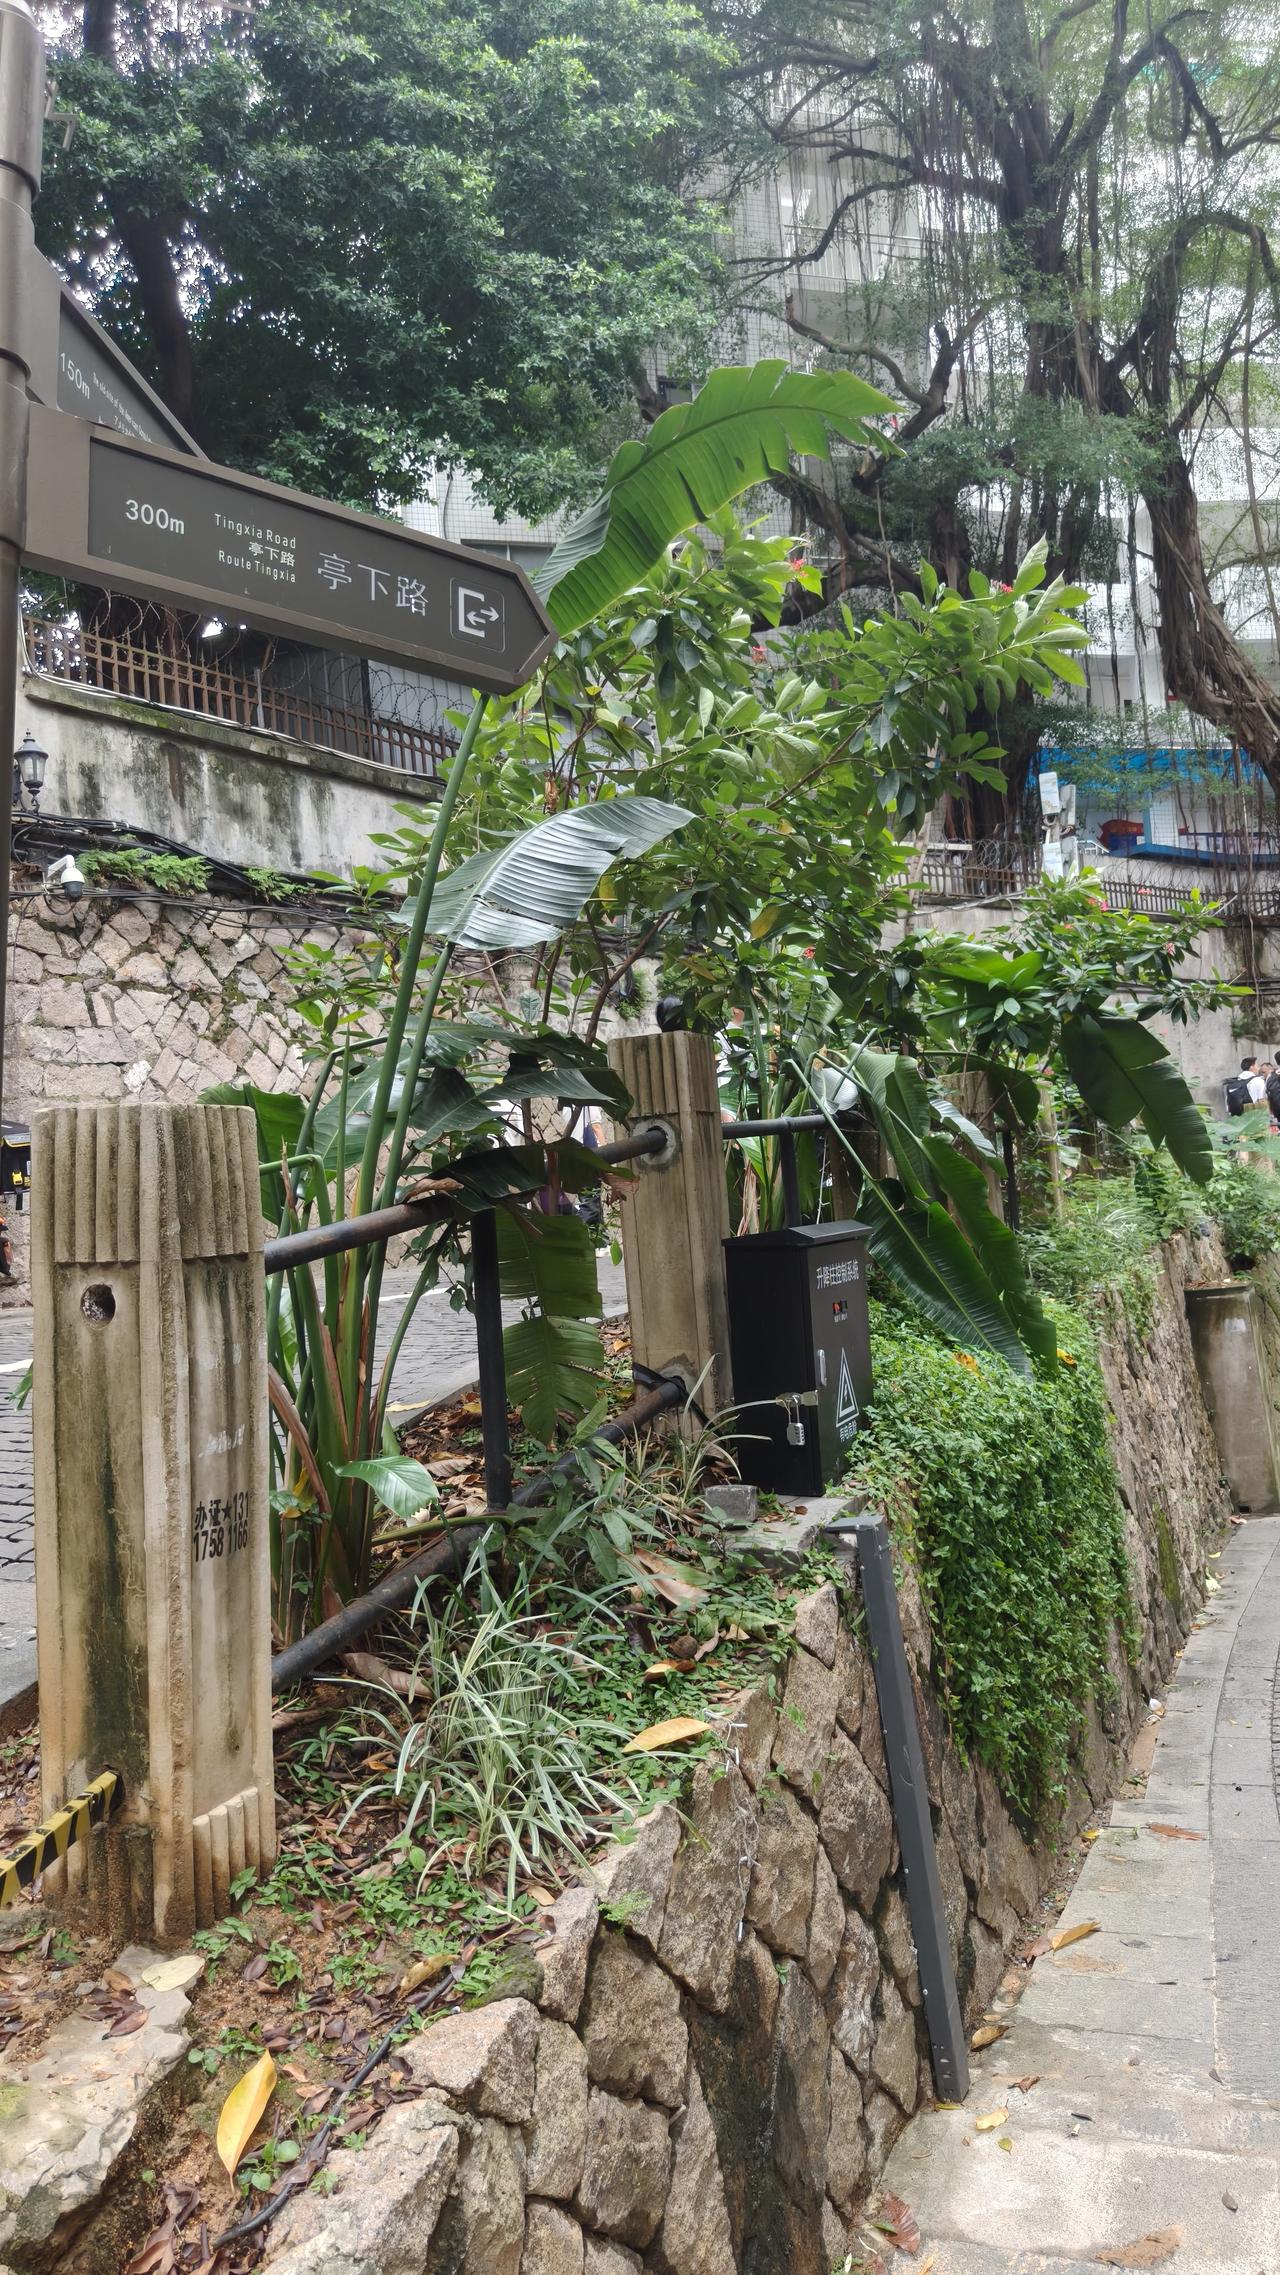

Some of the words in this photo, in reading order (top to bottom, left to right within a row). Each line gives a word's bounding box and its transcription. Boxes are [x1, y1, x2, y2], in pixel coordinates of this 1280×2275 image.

[60, 352, 90, 400] 150m
[125, 499, 185, 535] 300m
[214, 513, 263, 539] Tingxia
[266, 529, 296, 549] Road
[218, 550, 251, 570] Route
[254, 560, 296, 583] Tingxia
[248, 541, 296, 567] 亭下路
[317, 552, 429, 617] 亭下路
